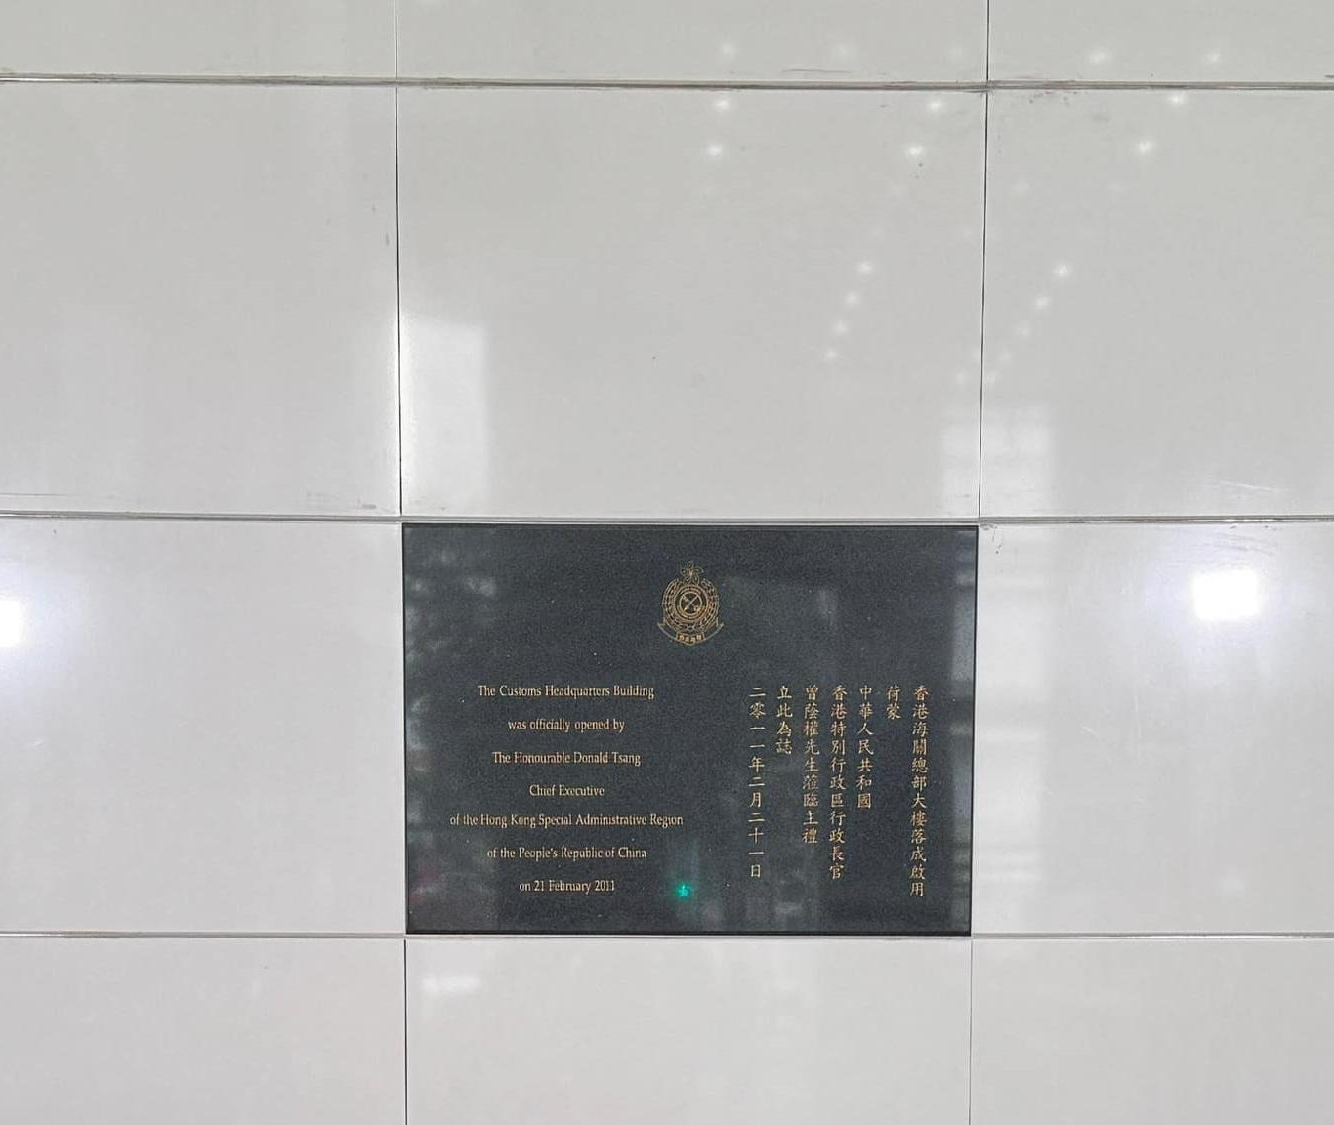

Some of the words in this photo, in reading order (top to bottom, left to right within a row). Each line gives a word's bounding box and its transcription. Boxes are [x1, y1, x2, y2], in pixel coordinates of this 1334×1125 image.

[478, 685, 495, 697] The
[499, 685, 542, 697] Customs
[545, 685, 610, 700] Headquarters
[613, 685, 654, 700] Building
[885, 685, 902, 721] 荷蒙
[508, 721, 527, 731] was
[529, 718, 571, 734] officially
[574, 718, 609, 735] opened
[613, 718, 625, 734] by
[856, 685, 874, 809] 中華人民共和國
[492, 751, 511, 764] The
[514, 751, 571, 764] Honourable
[573, 751, 609, 764] Donald
[611, 751, 641, 767] Tsang
[748, 687, 767, 878] 二零一一年二月二十一日
[828, 684, 848, 880] 香港特別行政區行政長官
[529, 784, 557, 797] Chief
[559, 784, 605, 797] Executive
[449, 813, 460, 826] of
[463, 813, 479, 826] the
[480, 813, 508, 829] Hong
[511, 813, 536, 829] Kong
[539, 813, 572, 829] Special
[575, 813, 647, 826] Administrative
[650, 813, 684, 829] Region
[487, 847, 498, 859] of
[500, 847, 516, 859] the
[518, 847, 559, 862] People's
[561, 847, 604, 862] Republic
[604, 847, 616, 859] of
[618, 847, 647, 859] China
[519, 882, 531, 892] on
[534, 880, 545, 892] 21
[549, 880, 592, 895] February
[595, 880, 615, 892] 2011
